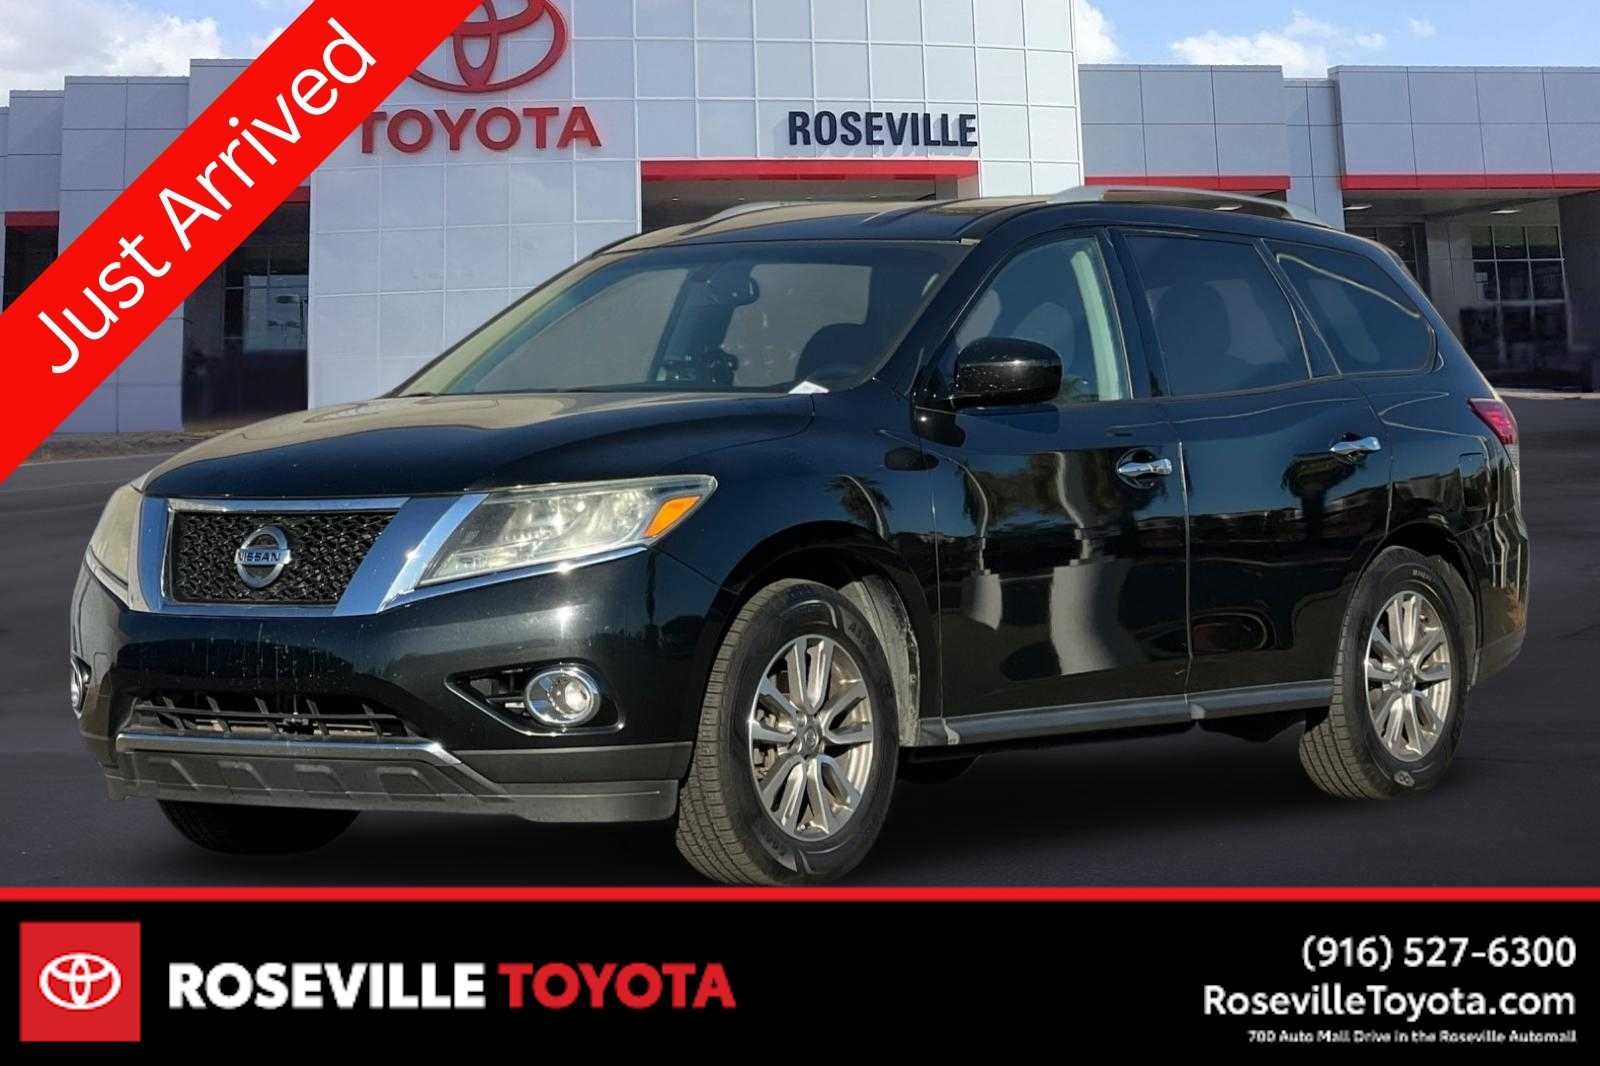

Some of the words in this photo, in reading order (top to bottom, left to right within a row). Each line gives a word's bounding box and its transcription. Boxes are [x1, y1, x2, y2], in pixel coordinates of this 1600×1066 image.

[361, 106, 602, 154] TOYOTA
[788, 111, 978, 147] ROSEVILLE
[237, 551, 282, 562] NISSAN
